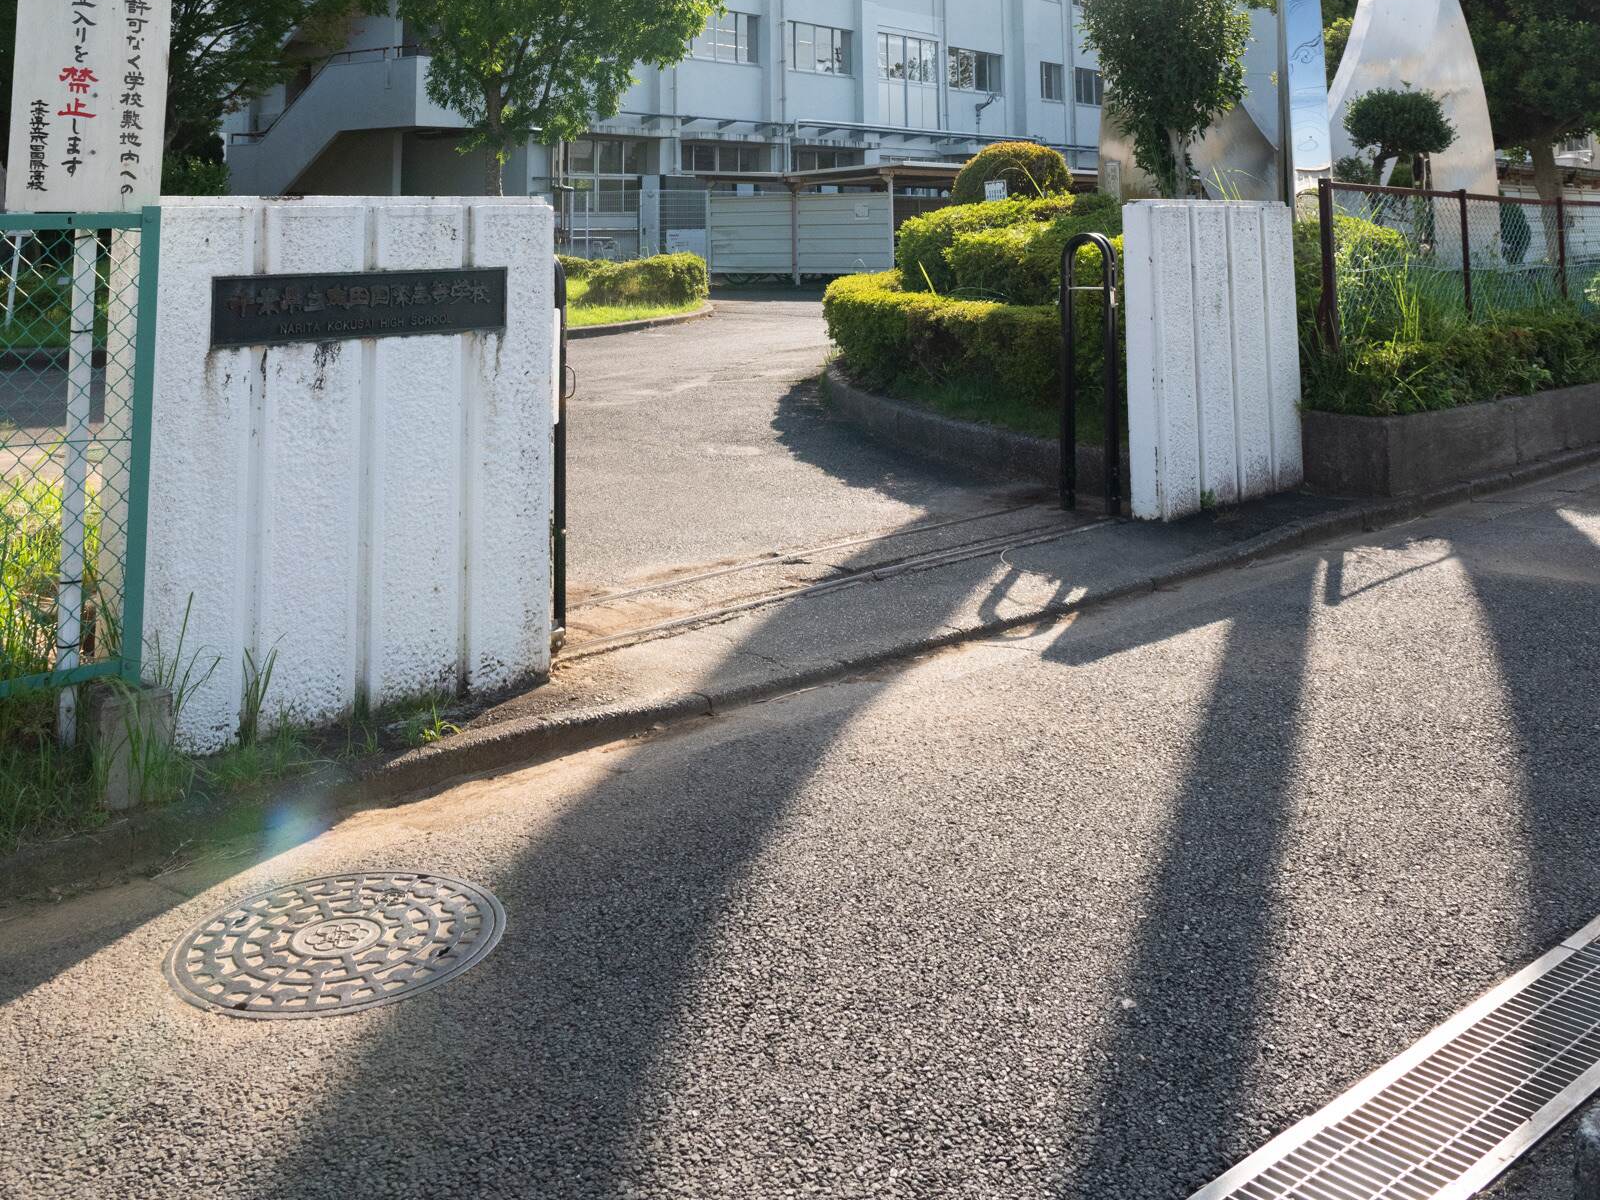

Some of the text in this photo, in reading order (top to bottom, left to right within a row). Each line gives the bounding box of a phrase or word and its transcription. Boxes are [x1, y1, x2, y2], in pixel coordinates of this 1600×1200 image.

[280, 312, 453, 336] NARITA KOKUSAI HIGH SCHOOL
